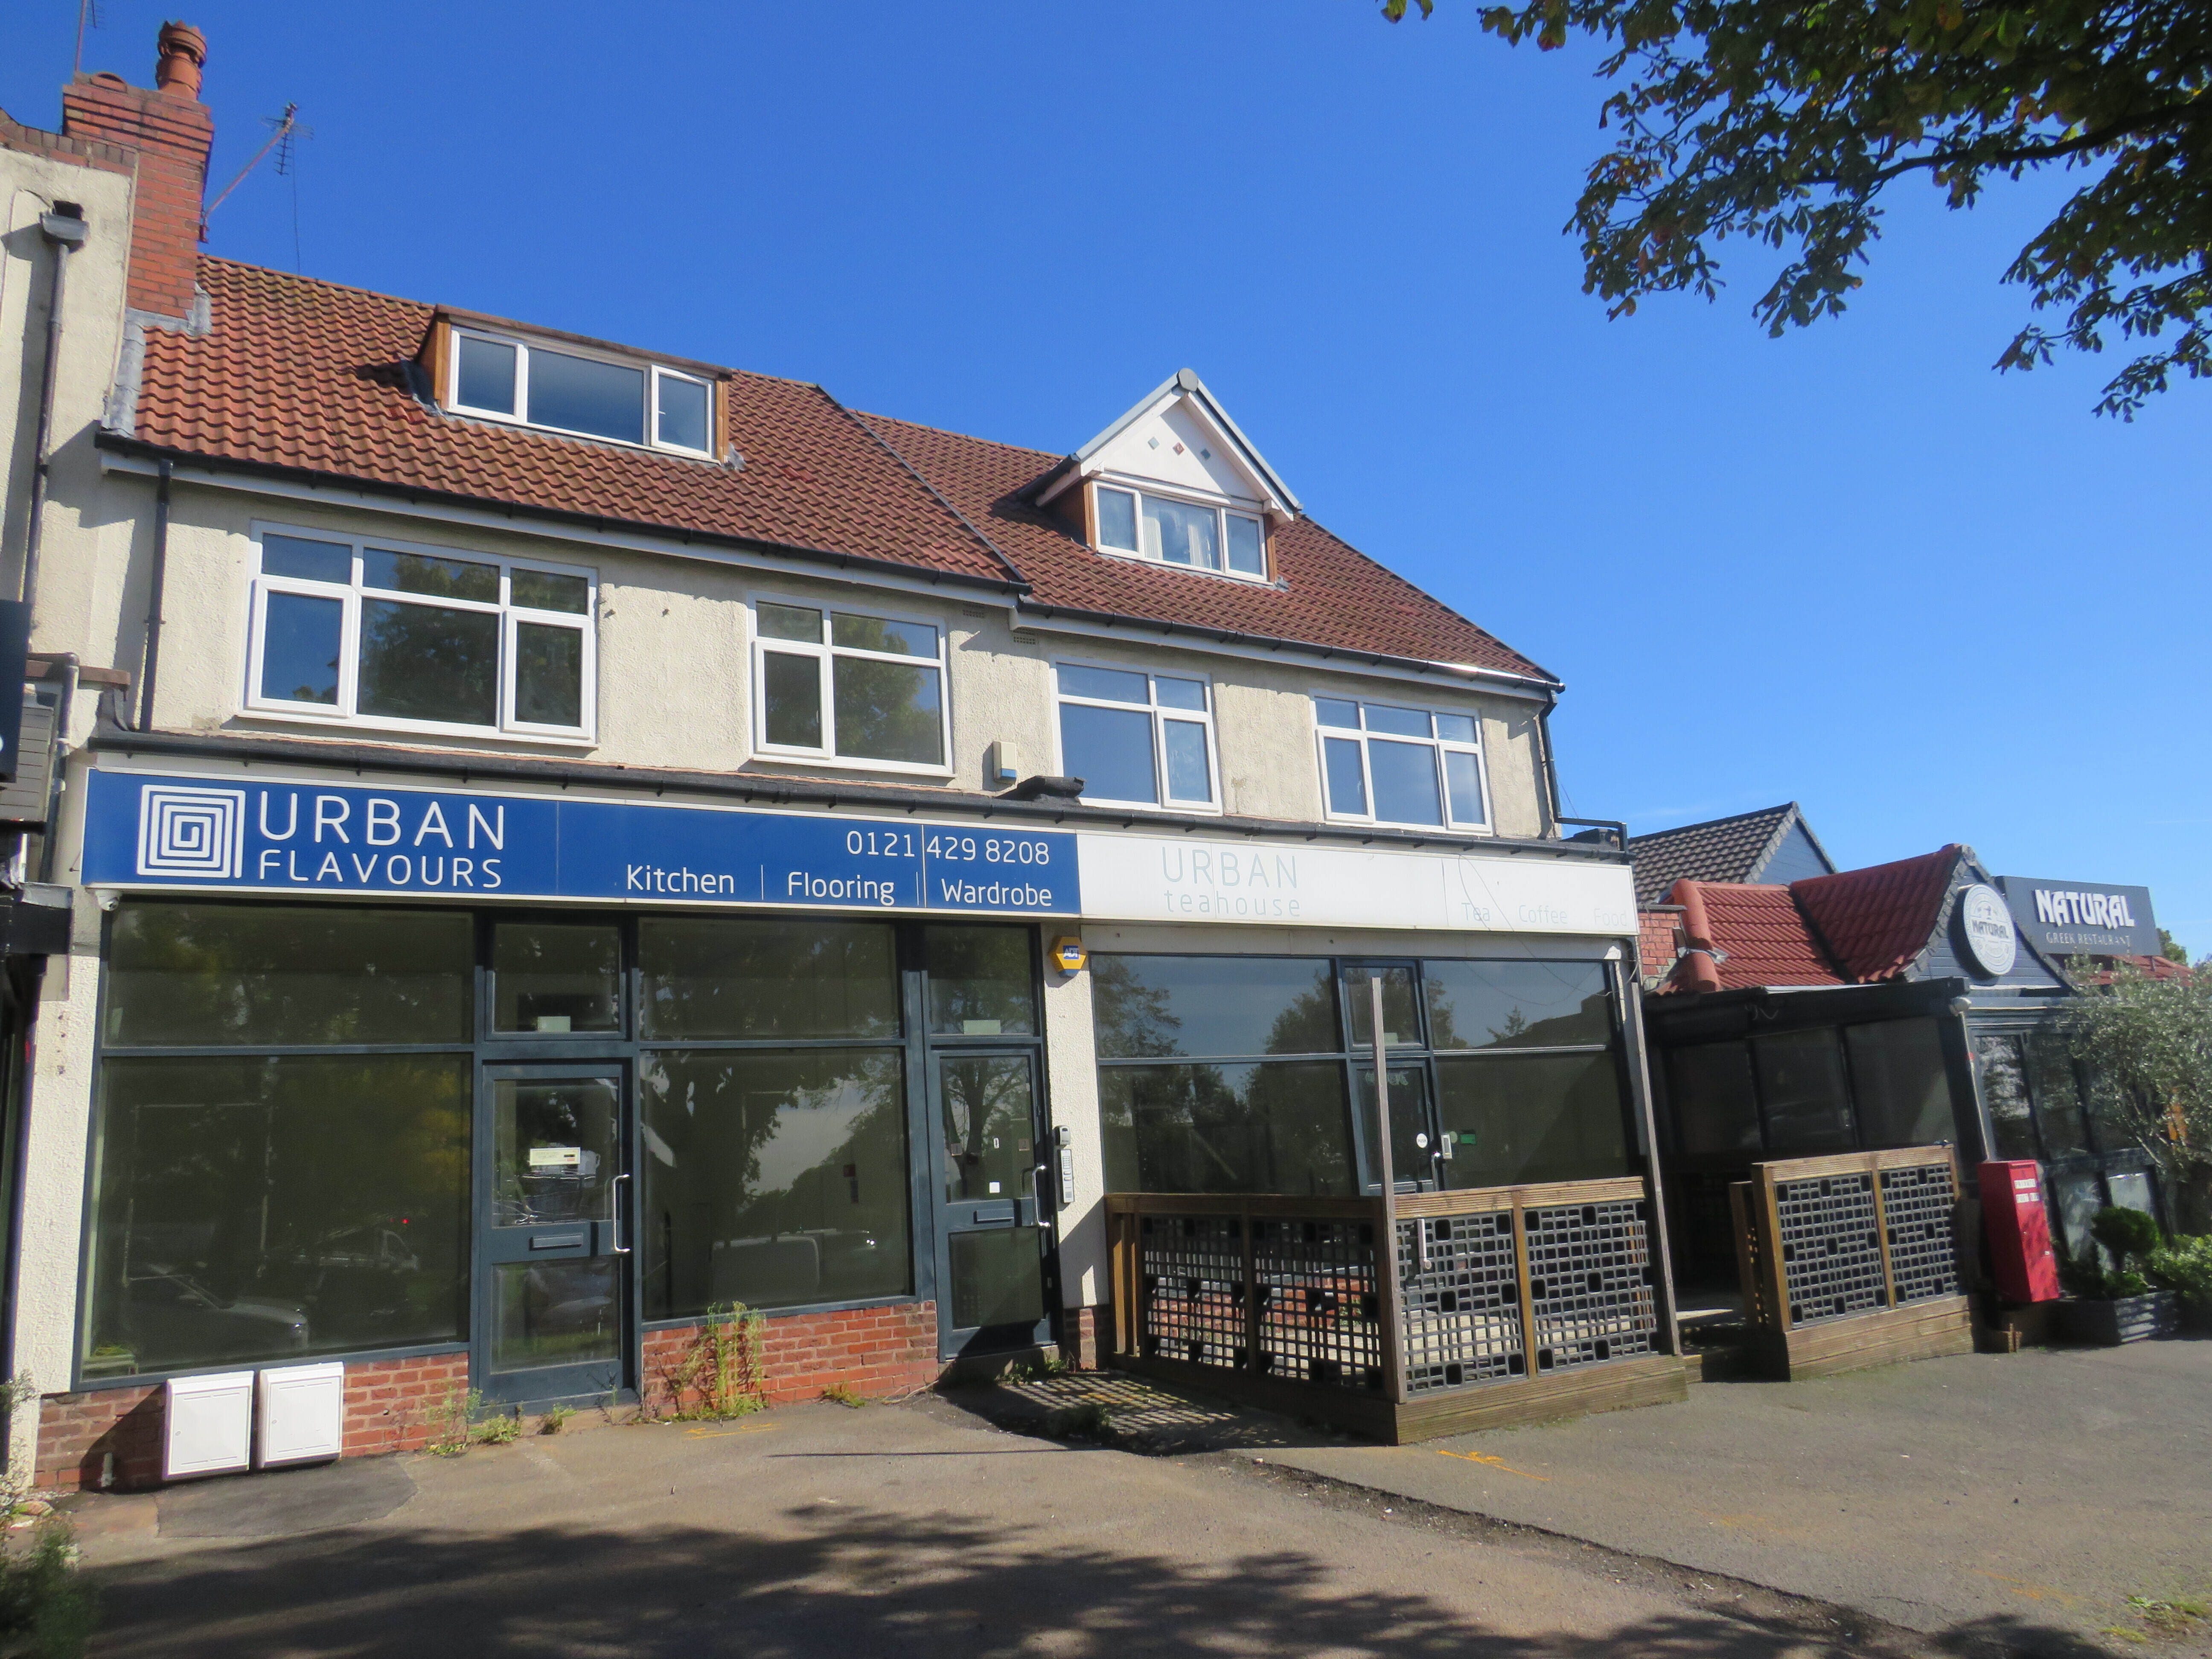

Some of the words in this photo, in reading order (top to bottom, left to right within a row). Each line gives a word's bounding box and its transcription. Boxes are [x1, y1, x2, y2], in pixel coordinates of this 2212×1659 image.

[259, 790, 504, 850] URBAN
[847, 830, 915, 857] 0121
[926, 835, 976, 861] 429
[986, 839, 1049, 865] 8208
[259, 849, 502, 888] FLAVOURS
[1162, 847, 1297, 888] URBAN
[628, 864, 734, 894] Kitchen
[788, 871, 894, 906] Flooring
[941, 878, 1052, 907] Wardrobe
[1164, 890, 1300, 917] teahouse
[1461, 902, 1490, 922] Tea
[1519, 905, 1568, 924] Coffee
[1594, 908, 1627, 926] Food
[2035, 889, 2135, 929] NATURAL
[1972, 919, 2008, 938] NATURAL
[2046, 932, 2075, 944] GREEK
[1063, 947, 1079, 958] ADT
